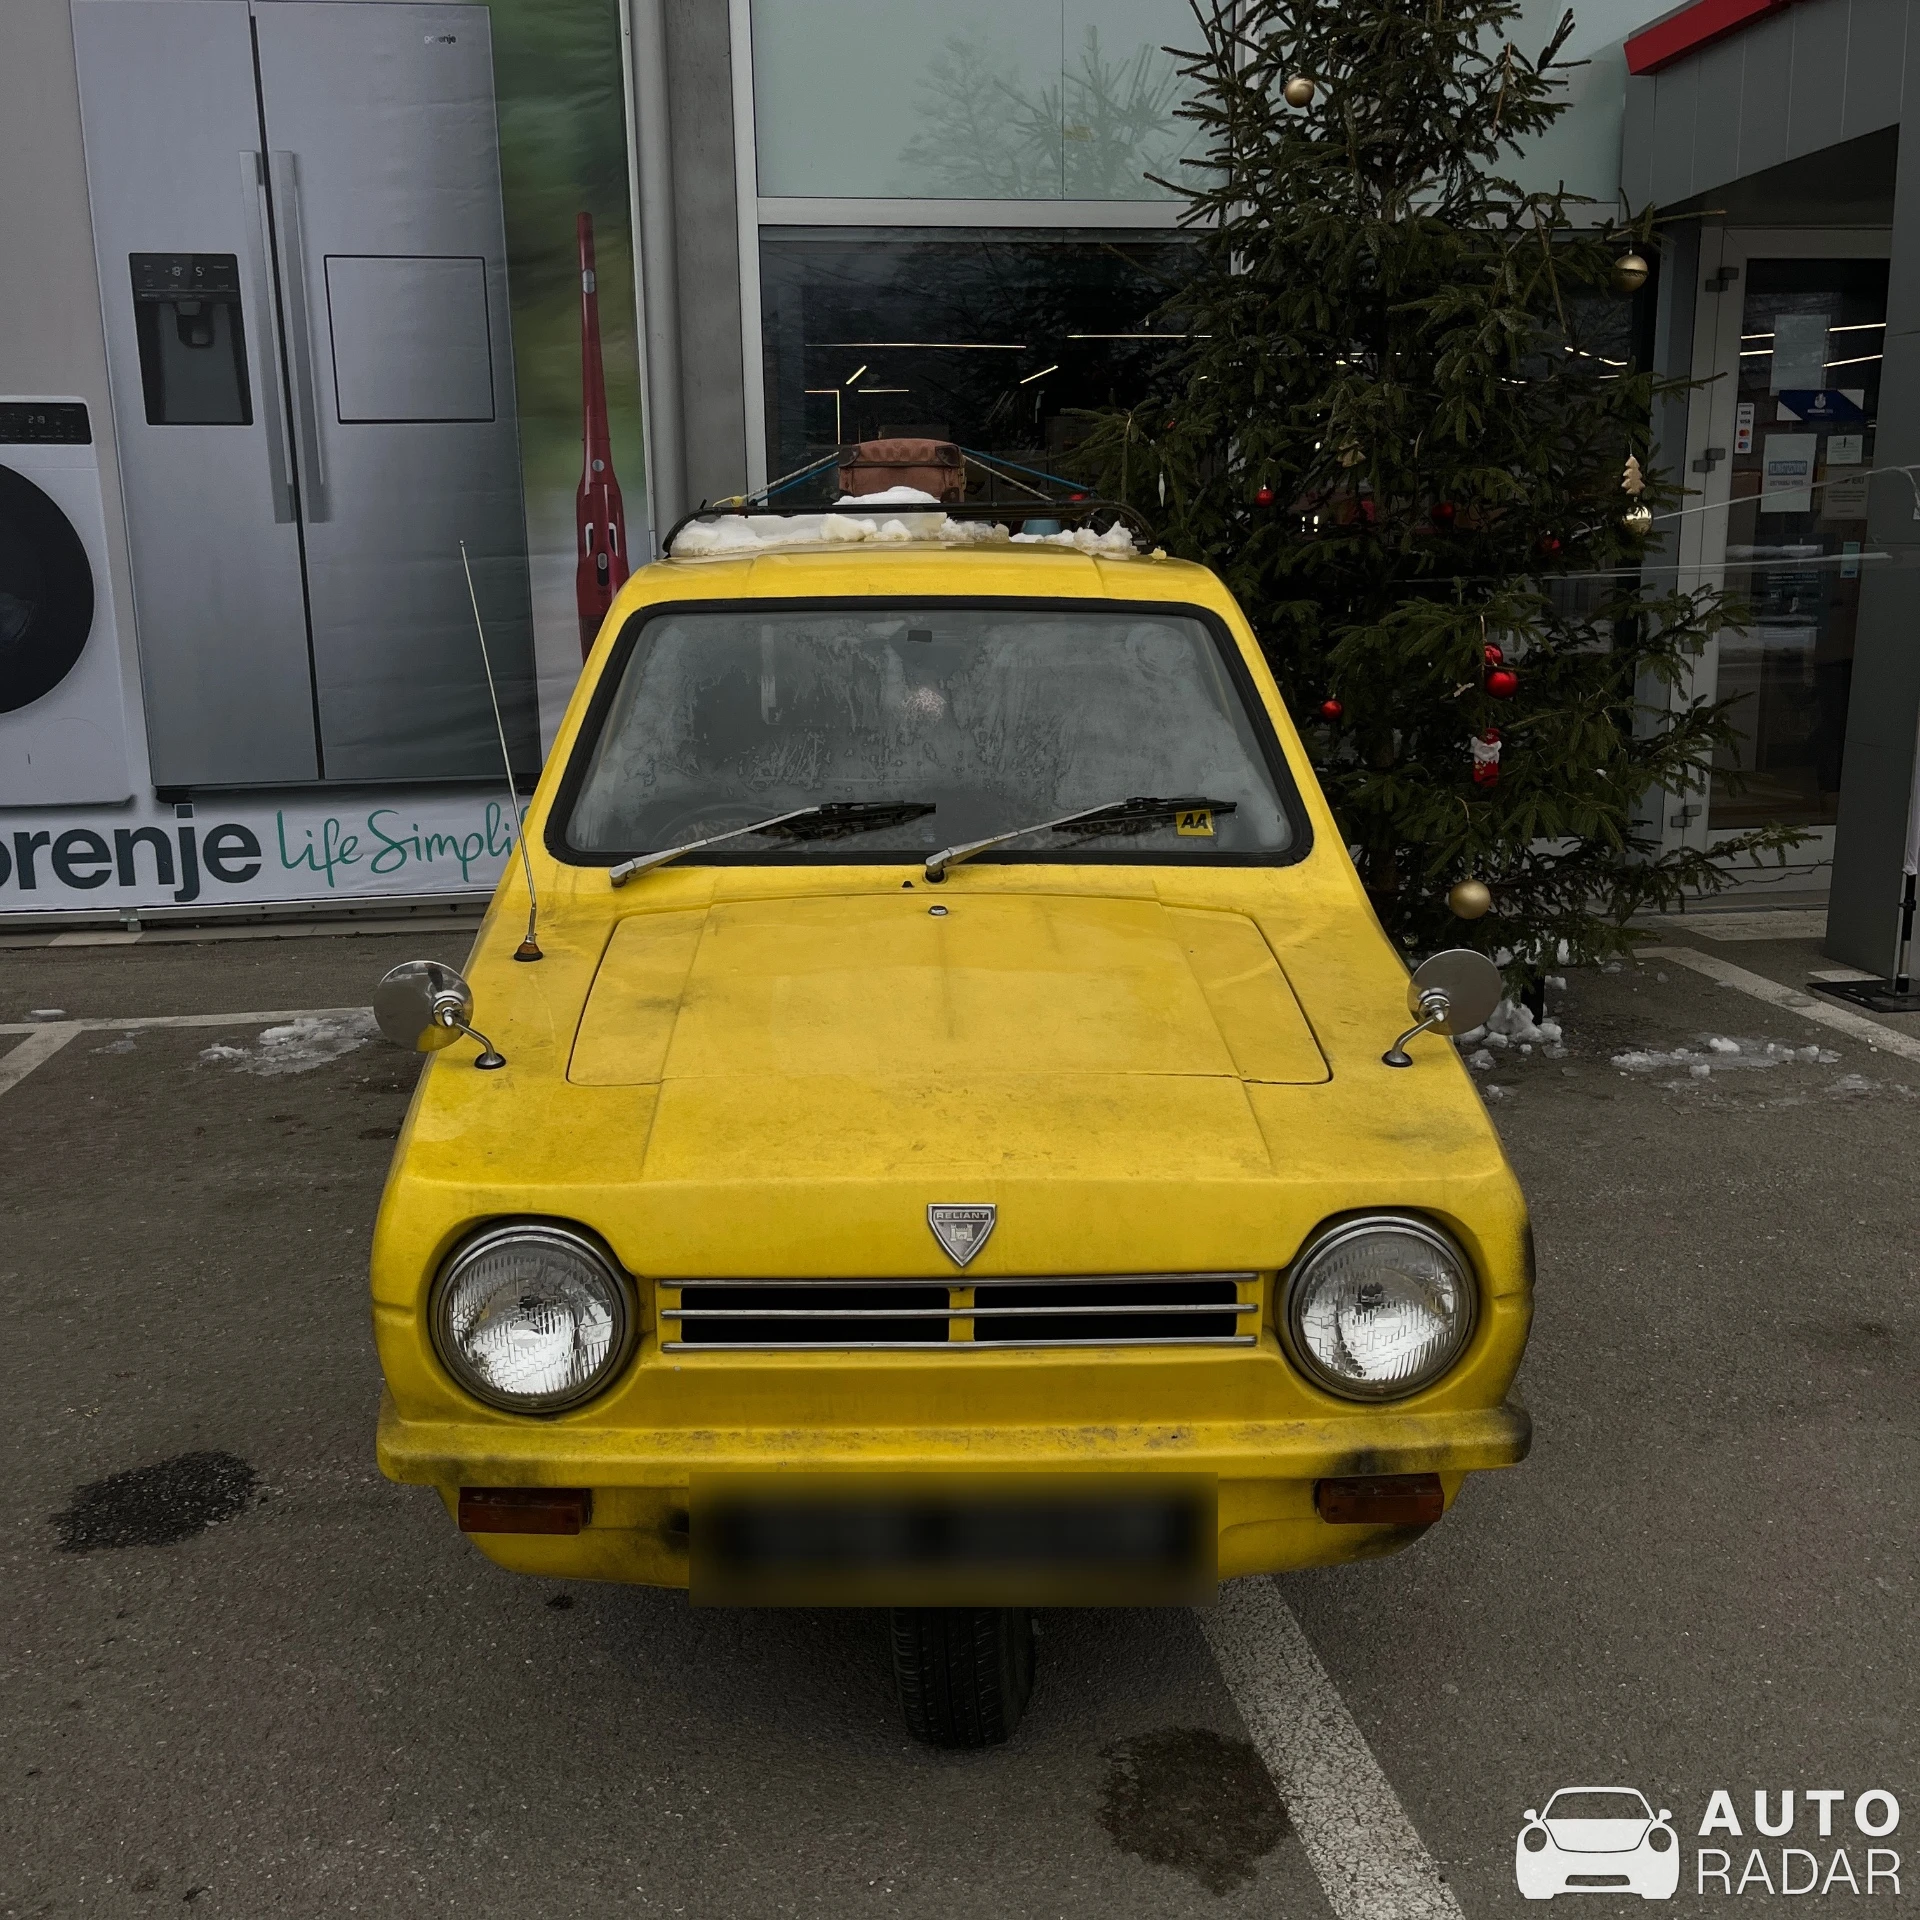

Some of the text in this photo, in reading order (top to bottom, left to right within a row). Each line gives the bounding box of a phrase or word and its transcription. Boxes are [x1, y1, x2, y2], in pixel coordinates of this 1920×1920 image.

[1180, 812, 1209, 829] AA
[0, 804, 262, 902] renje
[276, 809, 365, 887] Life
